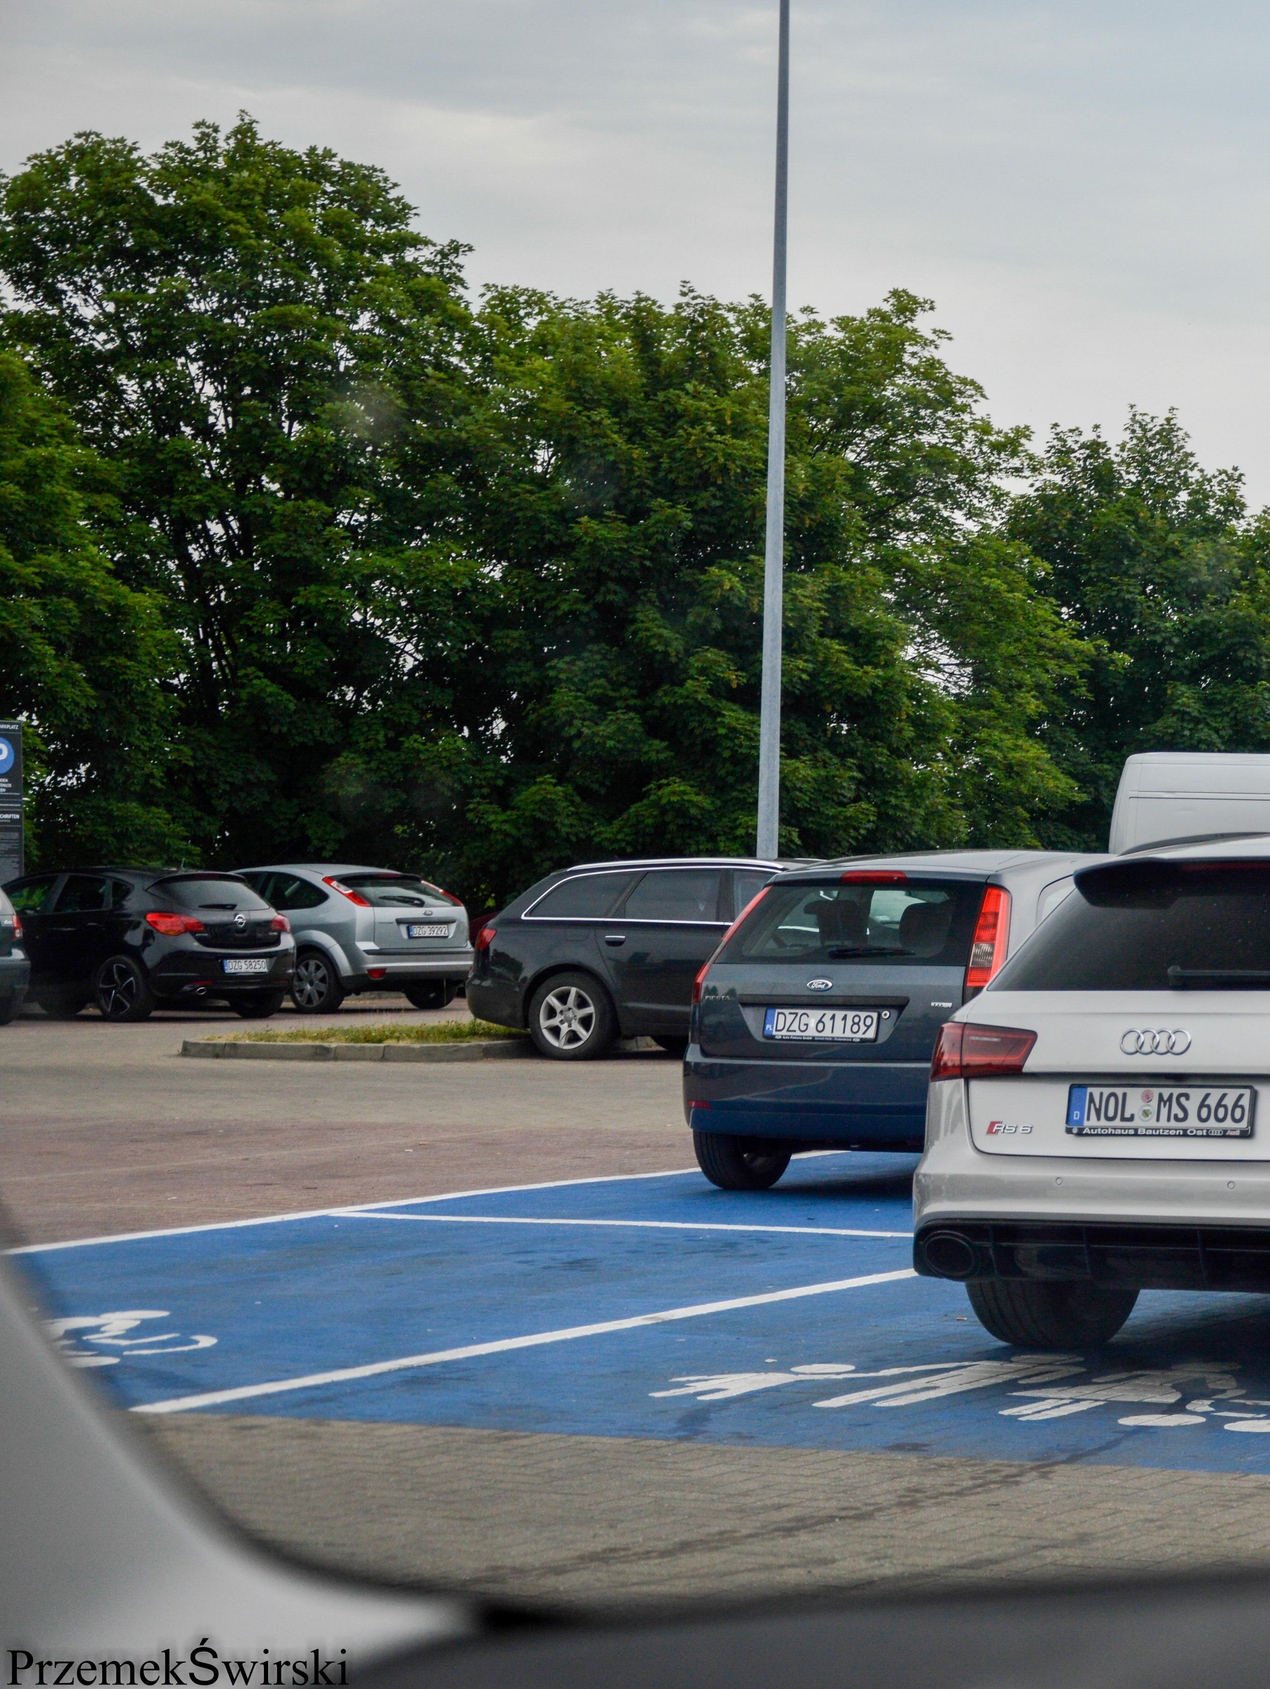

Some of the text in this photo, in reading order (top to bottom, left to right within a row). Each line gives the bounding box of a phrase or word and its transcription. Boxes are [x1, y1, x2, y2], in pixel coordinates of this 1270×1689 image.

[775, 1012, 874, 1035] DZG 61189
[1073, 1111, 1080, 1120] D
[1086, 1091, 1246, 1124] NOL MS 666
[1082, 1127, 1135, 1135] Autohaus
[1137, 1128, 1184, 1136] Bautzen
